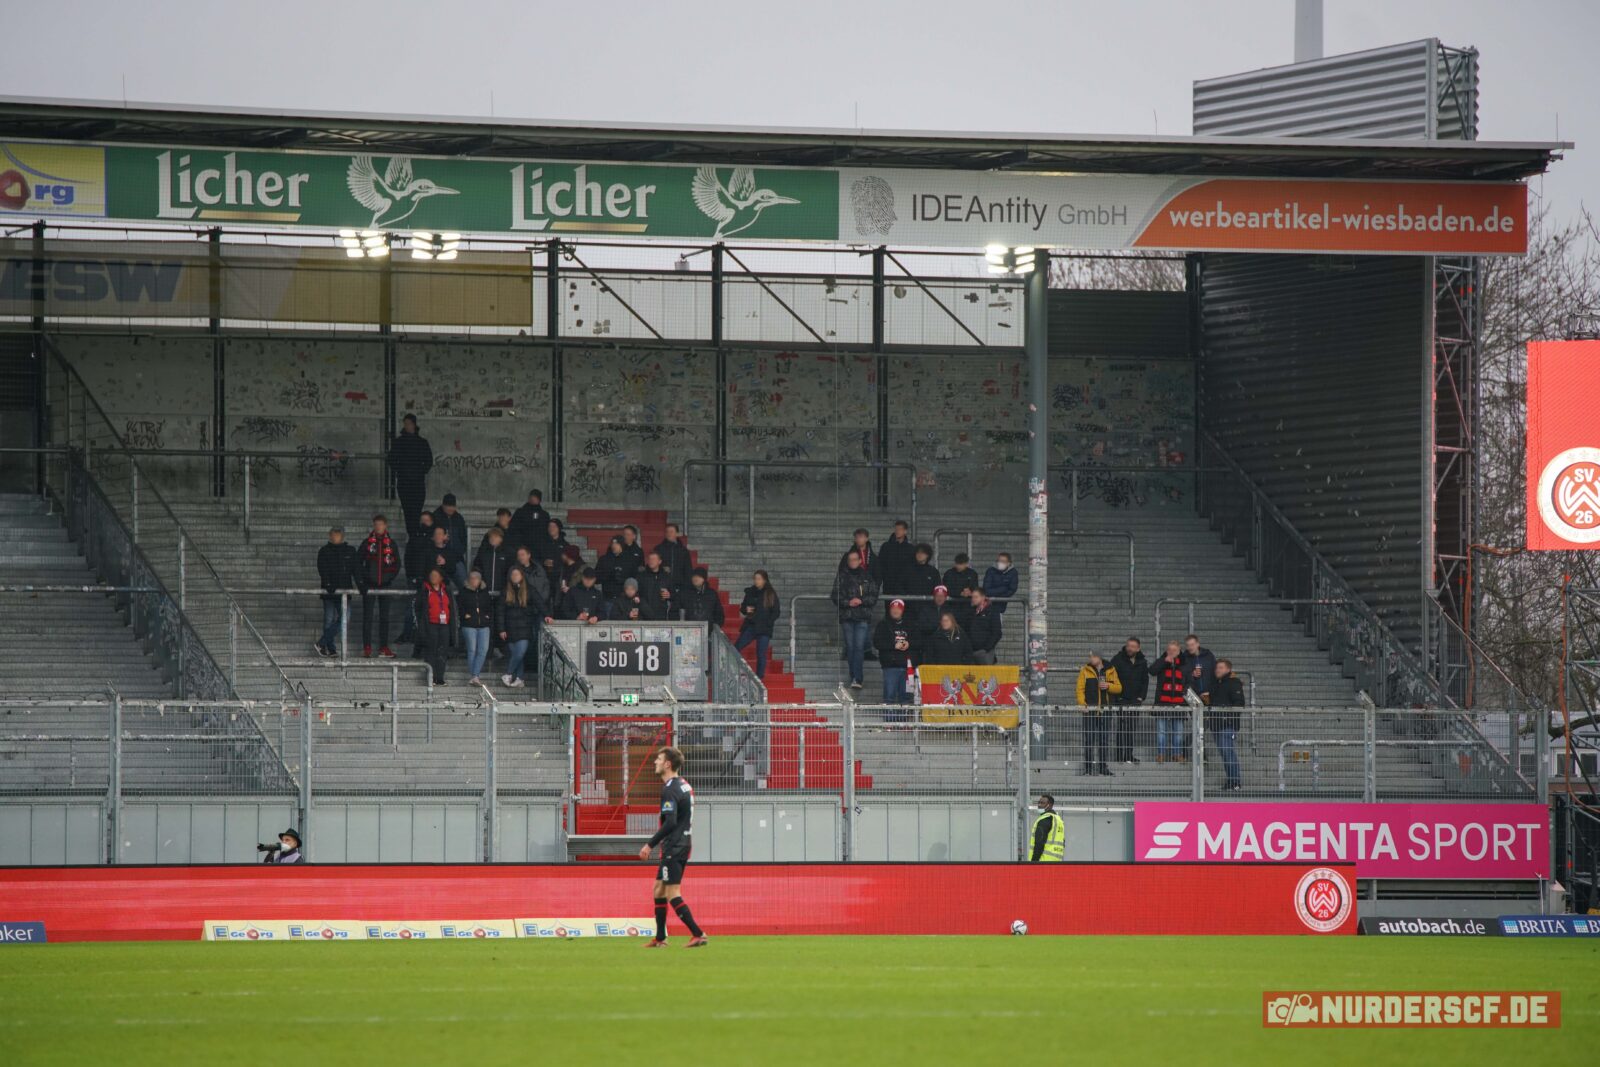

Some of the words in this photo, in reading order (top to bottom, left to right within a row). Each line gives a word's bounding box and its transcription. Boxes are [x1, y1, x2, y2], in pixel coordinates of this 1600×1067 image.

[155, 150, 310, 219] Licher
[509, 163, 657, 231] Licher
[912, 193, 1048, 231] IDEAntity
[1058, 203, 1128, 226] GmbH
[1169, 200, 1515, 234] werbeartikel-wiesbaden.de
[1574, 468, 1595, 483] SV
[1575, 510, 1594, 524] 26
[599, 647, 628, 668] SÜD
[635, 644, 660, 672] 18
[1197, 821, 1399, 861] MAGENTA
[1407, 822, 1541, 862] SPORT
[1317, 882, 1329, 892] SV
[1318, 909, 1329, 918] 26
[1378, 918, 1486, 935] autobach.de
[1520, 919, 1567, 933] BRITA
